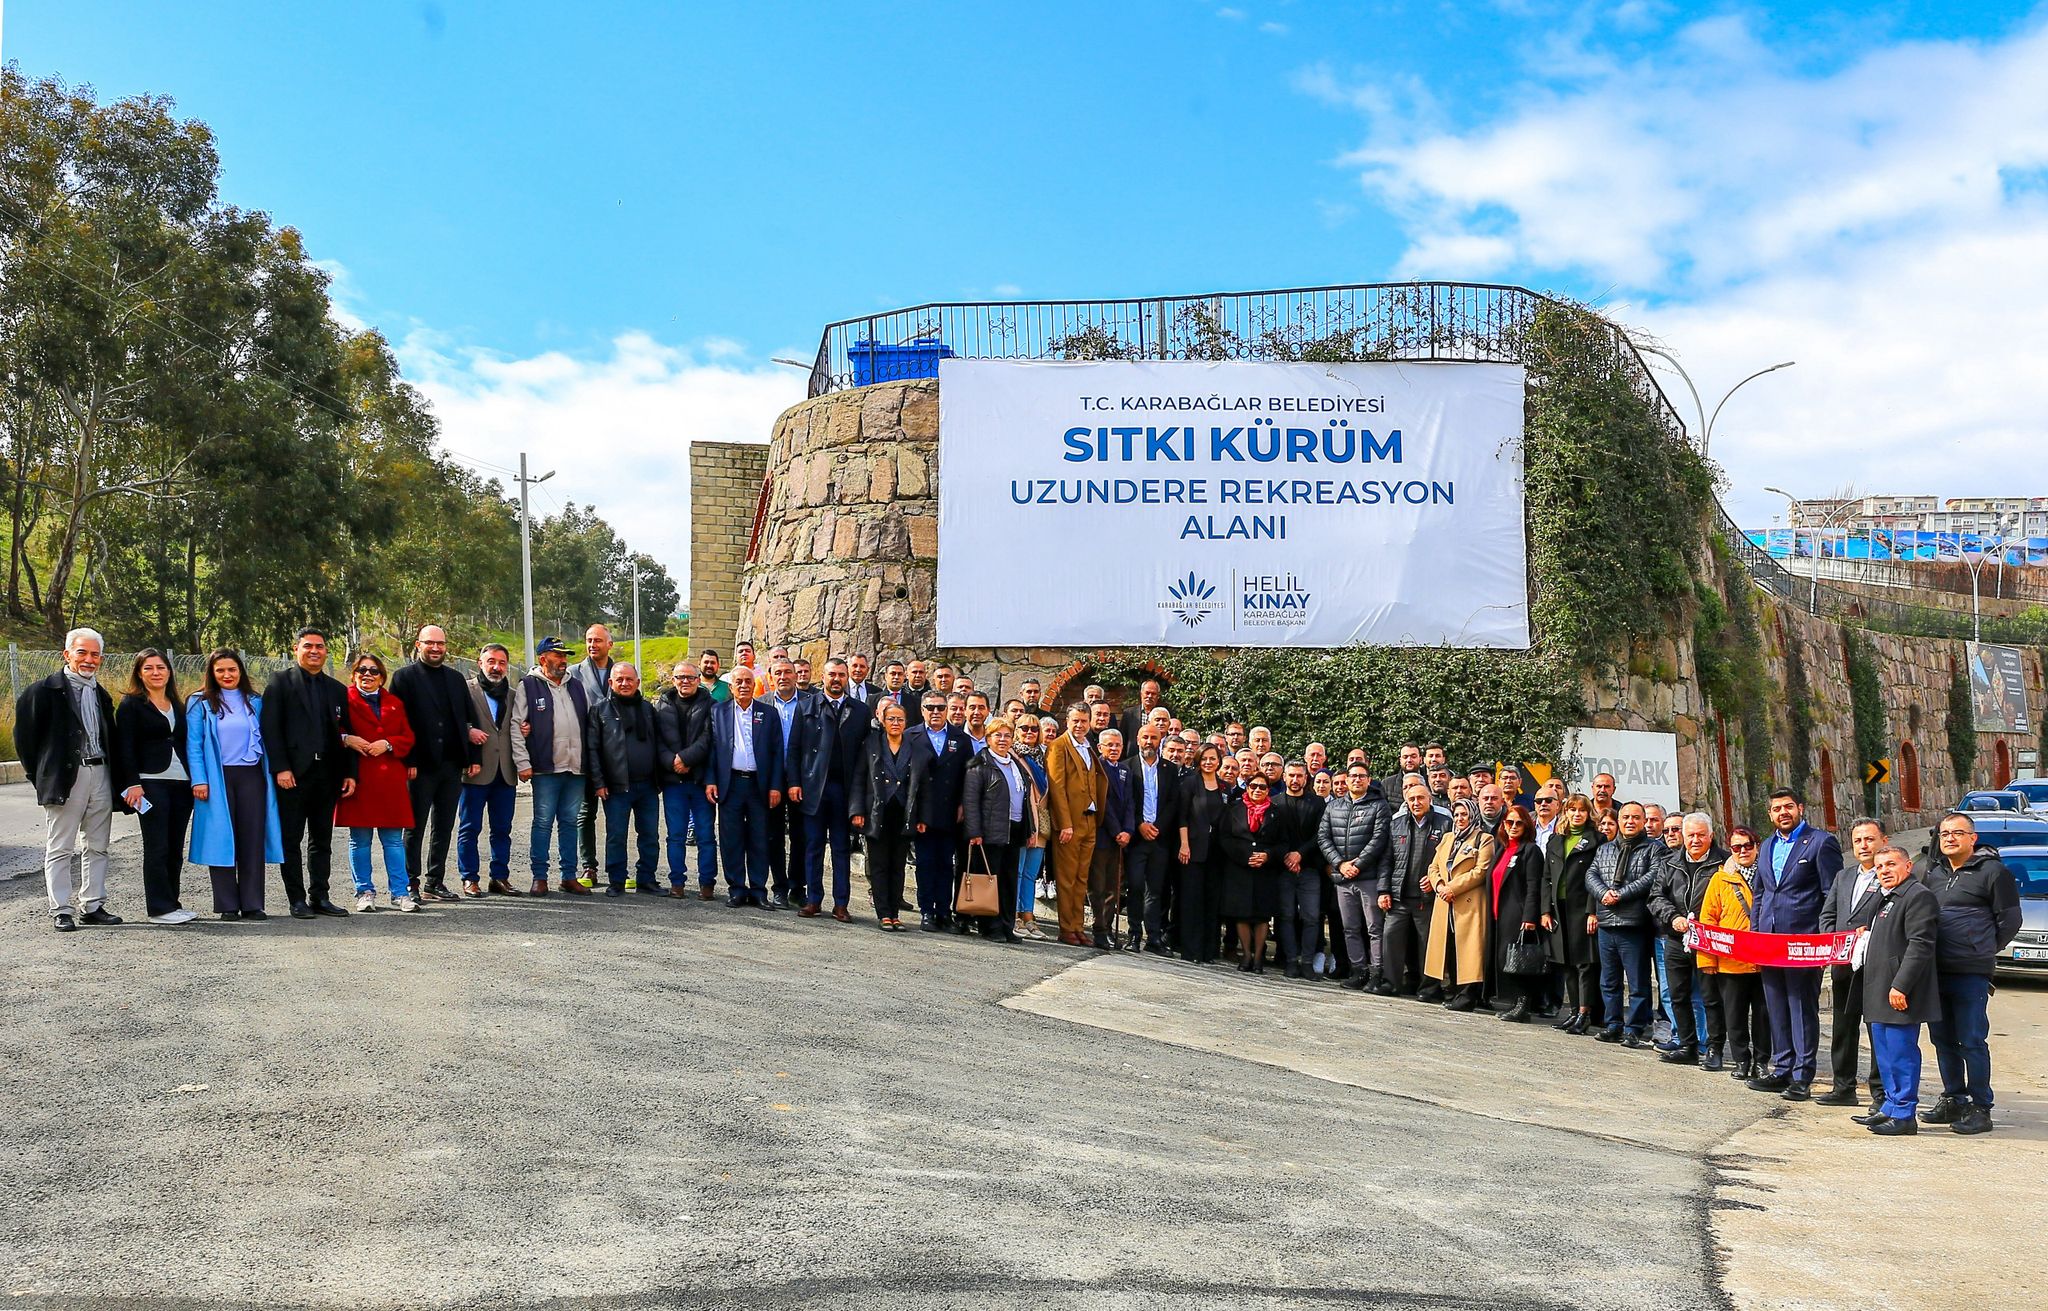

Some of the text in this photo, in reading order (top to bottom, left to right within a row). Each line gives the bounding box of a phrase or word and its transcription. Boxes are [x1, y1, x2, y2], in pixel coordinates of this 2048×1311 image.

[1080, 393, 1385, 413] T.C. KARABAĞLAR BELEDİYESİ
[1063, 417, 1403, 464] SITKI KÜRÜM
[1011, 479, 1454, 506] UZUNDERE REKREASYON
[1179, 515, 1286, 540] ALANI
[1243, 572, 1305, 592] HELİL
[1157, 601, 1193, 609] KARABAĞLAR
[1243, 593, 1311, 609] KINAY
[1243, 610, 1307, 619] KARABAĞLAR
[1243, 619, 1306, 628] BELEDİYE BAŞKANI
[2020, 949, 2030, 958] 35
